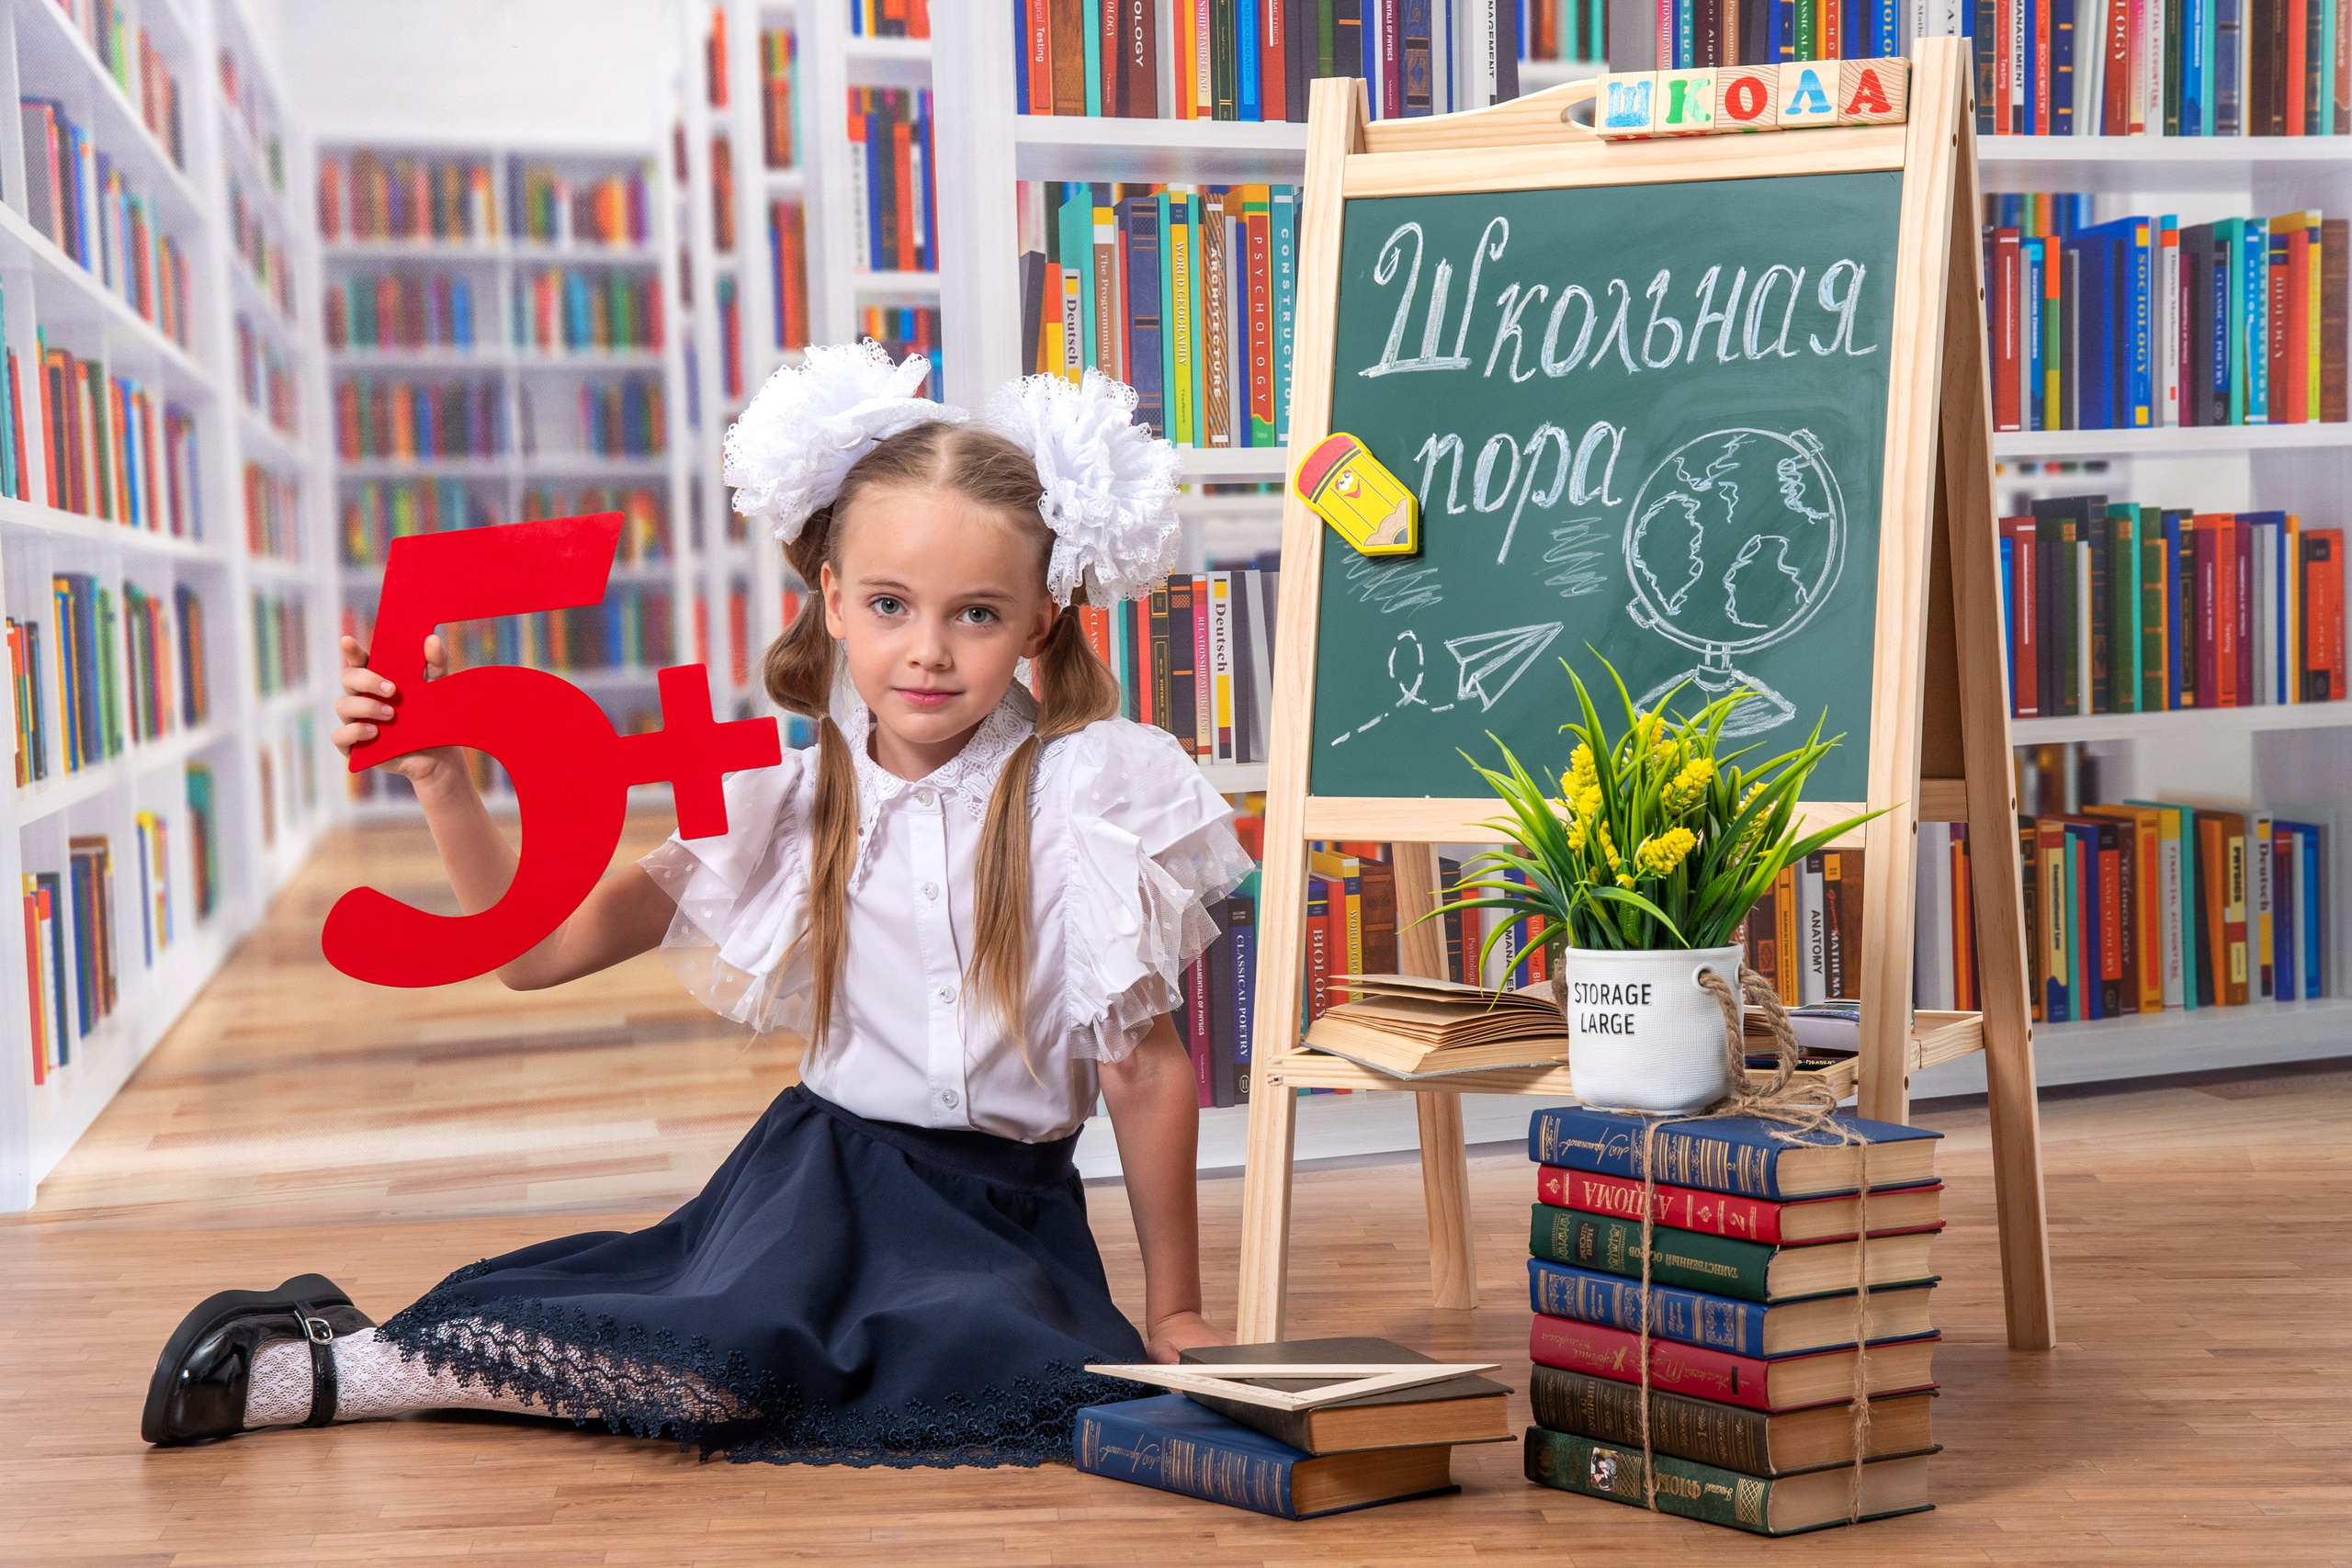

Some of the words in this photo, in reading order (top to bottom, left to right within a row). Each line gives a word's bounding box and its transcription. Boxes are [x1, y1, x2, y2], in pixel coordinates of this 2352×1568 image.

[1035, 27, 1046, 62] Testing
[1105, 0, 1115, 38] OLOGY
[1134, 1, 1144, 67] OLOGY
[1244, 0, 1252, 82] ROECONOMICS
[1605, 69, 1893, 128] ШКОЛА
[1998, 58, 2008, 90] Testing
[1100, 252, 1109, 275] The
[1175, 241, 1185, 288] WORLD
[1101, 278, 1112, 360] Programming
[1210, 247, 1222, 399] ARCHITECTURE
[1253, 236, 1267, 403] PSYCHOLOGY
[1280, 228, 1293, 417] CONSTRUCTION
[1358, 216, 1878, 383] Школьная
[2137, 254, 2147, 375] SOCIOLOGY
[1066, 299, 1080, 366] Deutsch
[1176, 289, 1188, 367] GEOGRAPHY
[1413, 420, 1626, 565] пора
[1091, 612, 1099, 653] CLASS
[1197, 616, 1208, 680] RELATIONSHIP
[1215, 602, 1228, 672] Deutsch
[1199, 681, 1209, 735] MARKETING
[2259, 842, 2270, 912] Deutsch
[1350, 909, 1359, 951] WORLD
[1811, 908, 1823, 975] ANATOMY
[1236, 934, 1247, 1005] CLASSICAL
[1312, 929, 1326, 1019] BIOLOGY
[1574, 981, 1652, 1006] STORAGE
[1197, 1001, 1204, 1010] OF
[1238, 1007, 1249, 1057] POETRY
[1580, 1012, 1635, 1035] LARGE
[1582, 1180, 1646, 1217] ДЮМА
[1729, 1212, 1746, 1232] 2
[1579, 1222, 1589, 1260] ЖЮЛЬ
[1586, 1226, 1595, 1258] ВЕРН
[1628, 1247, 1663, 1262] ОСРОВ
[1664, 1253, 1738, 1279] ТАИНСТВЕННЫЙ
